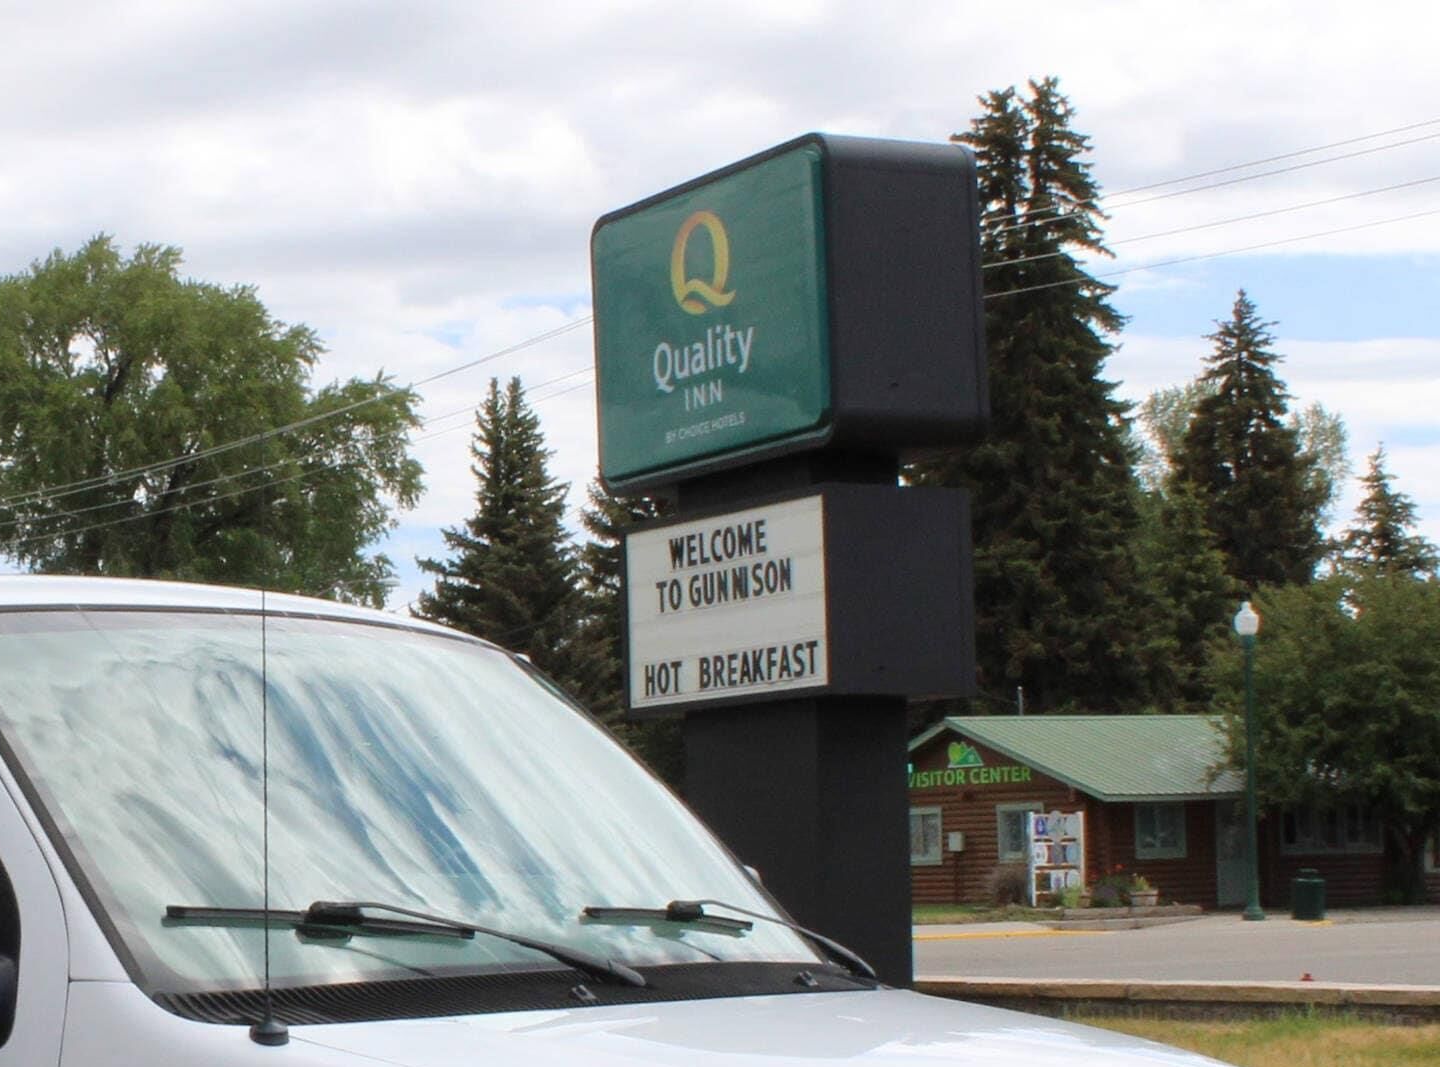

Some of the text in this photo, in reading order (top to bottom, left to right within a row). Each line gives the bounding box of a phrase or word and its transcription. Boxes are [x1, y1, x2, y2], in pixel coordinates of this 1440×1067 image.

[671, 210, 736, 315] Q
[654, 324, 755, 393] Quality
[684, 379, 722, 411] INN
[668, 519, 767, 569] WELCOME
[656, 557, 791, 613] TO GUNNISON
[645, 640, 818, 697] HOT BREAKFAST
[970, 766, 1031, 784] CENTER
